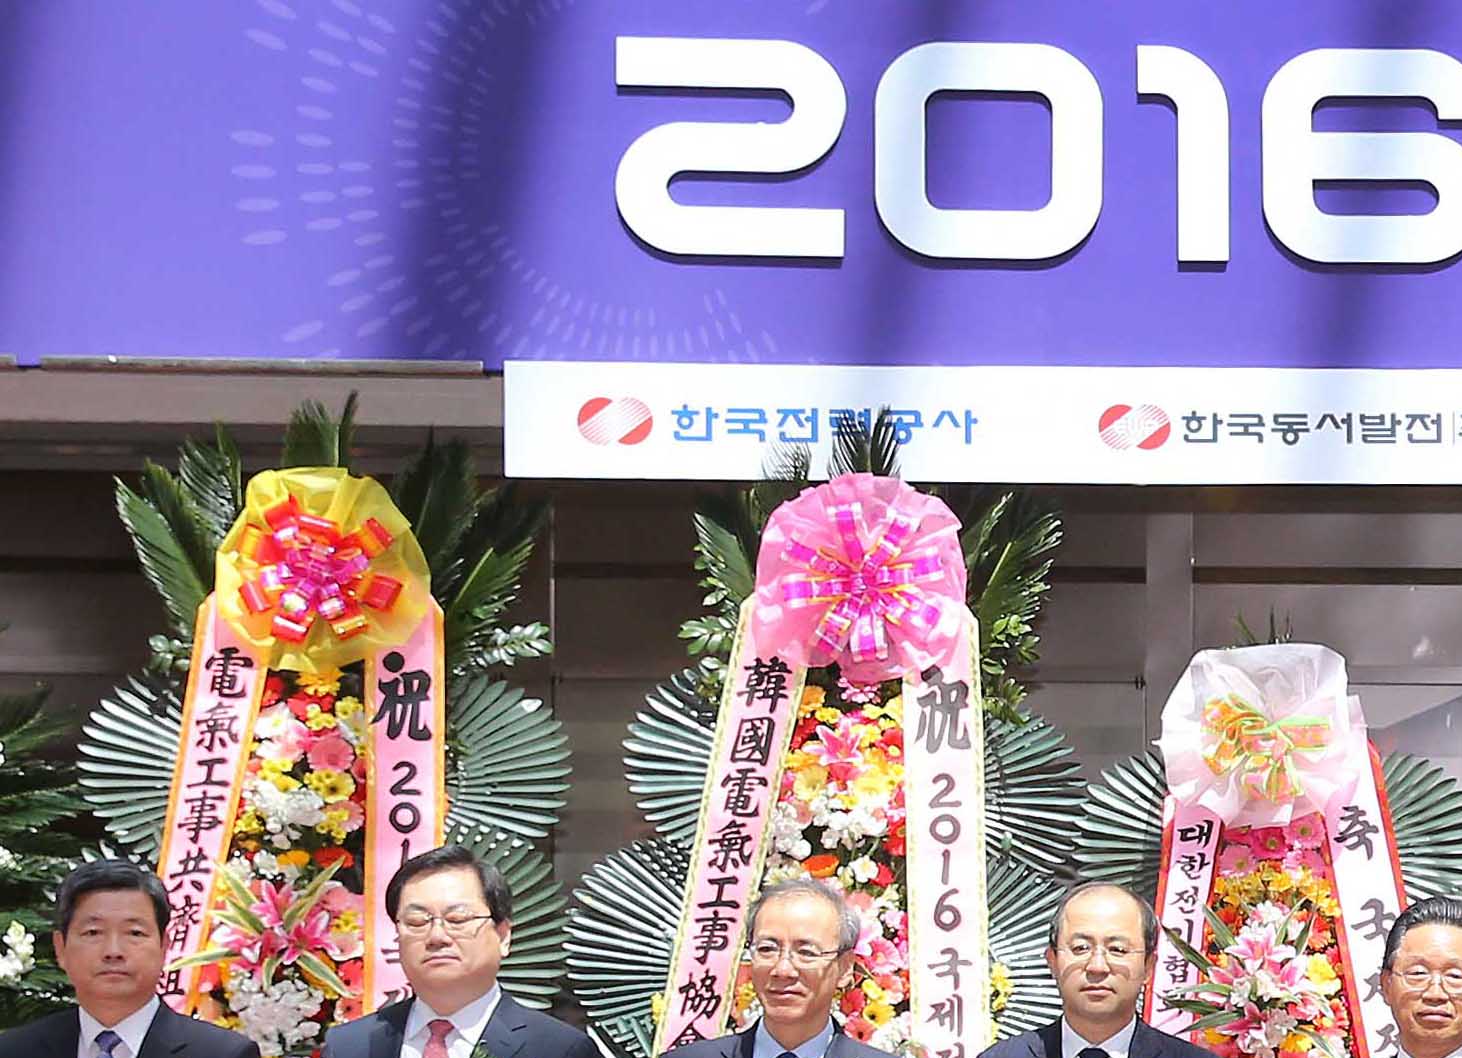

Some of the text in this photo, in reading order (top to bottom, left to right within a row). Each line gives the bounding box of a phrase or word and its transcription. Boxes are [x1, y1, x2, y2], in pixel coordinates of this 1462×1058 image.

[671, 403, 978, 446] 한국전력공사
[371, 650, 432, 742] 祝
[914, 665, 971, 755] 祝
[1333, 805, 1380, 861] 축
